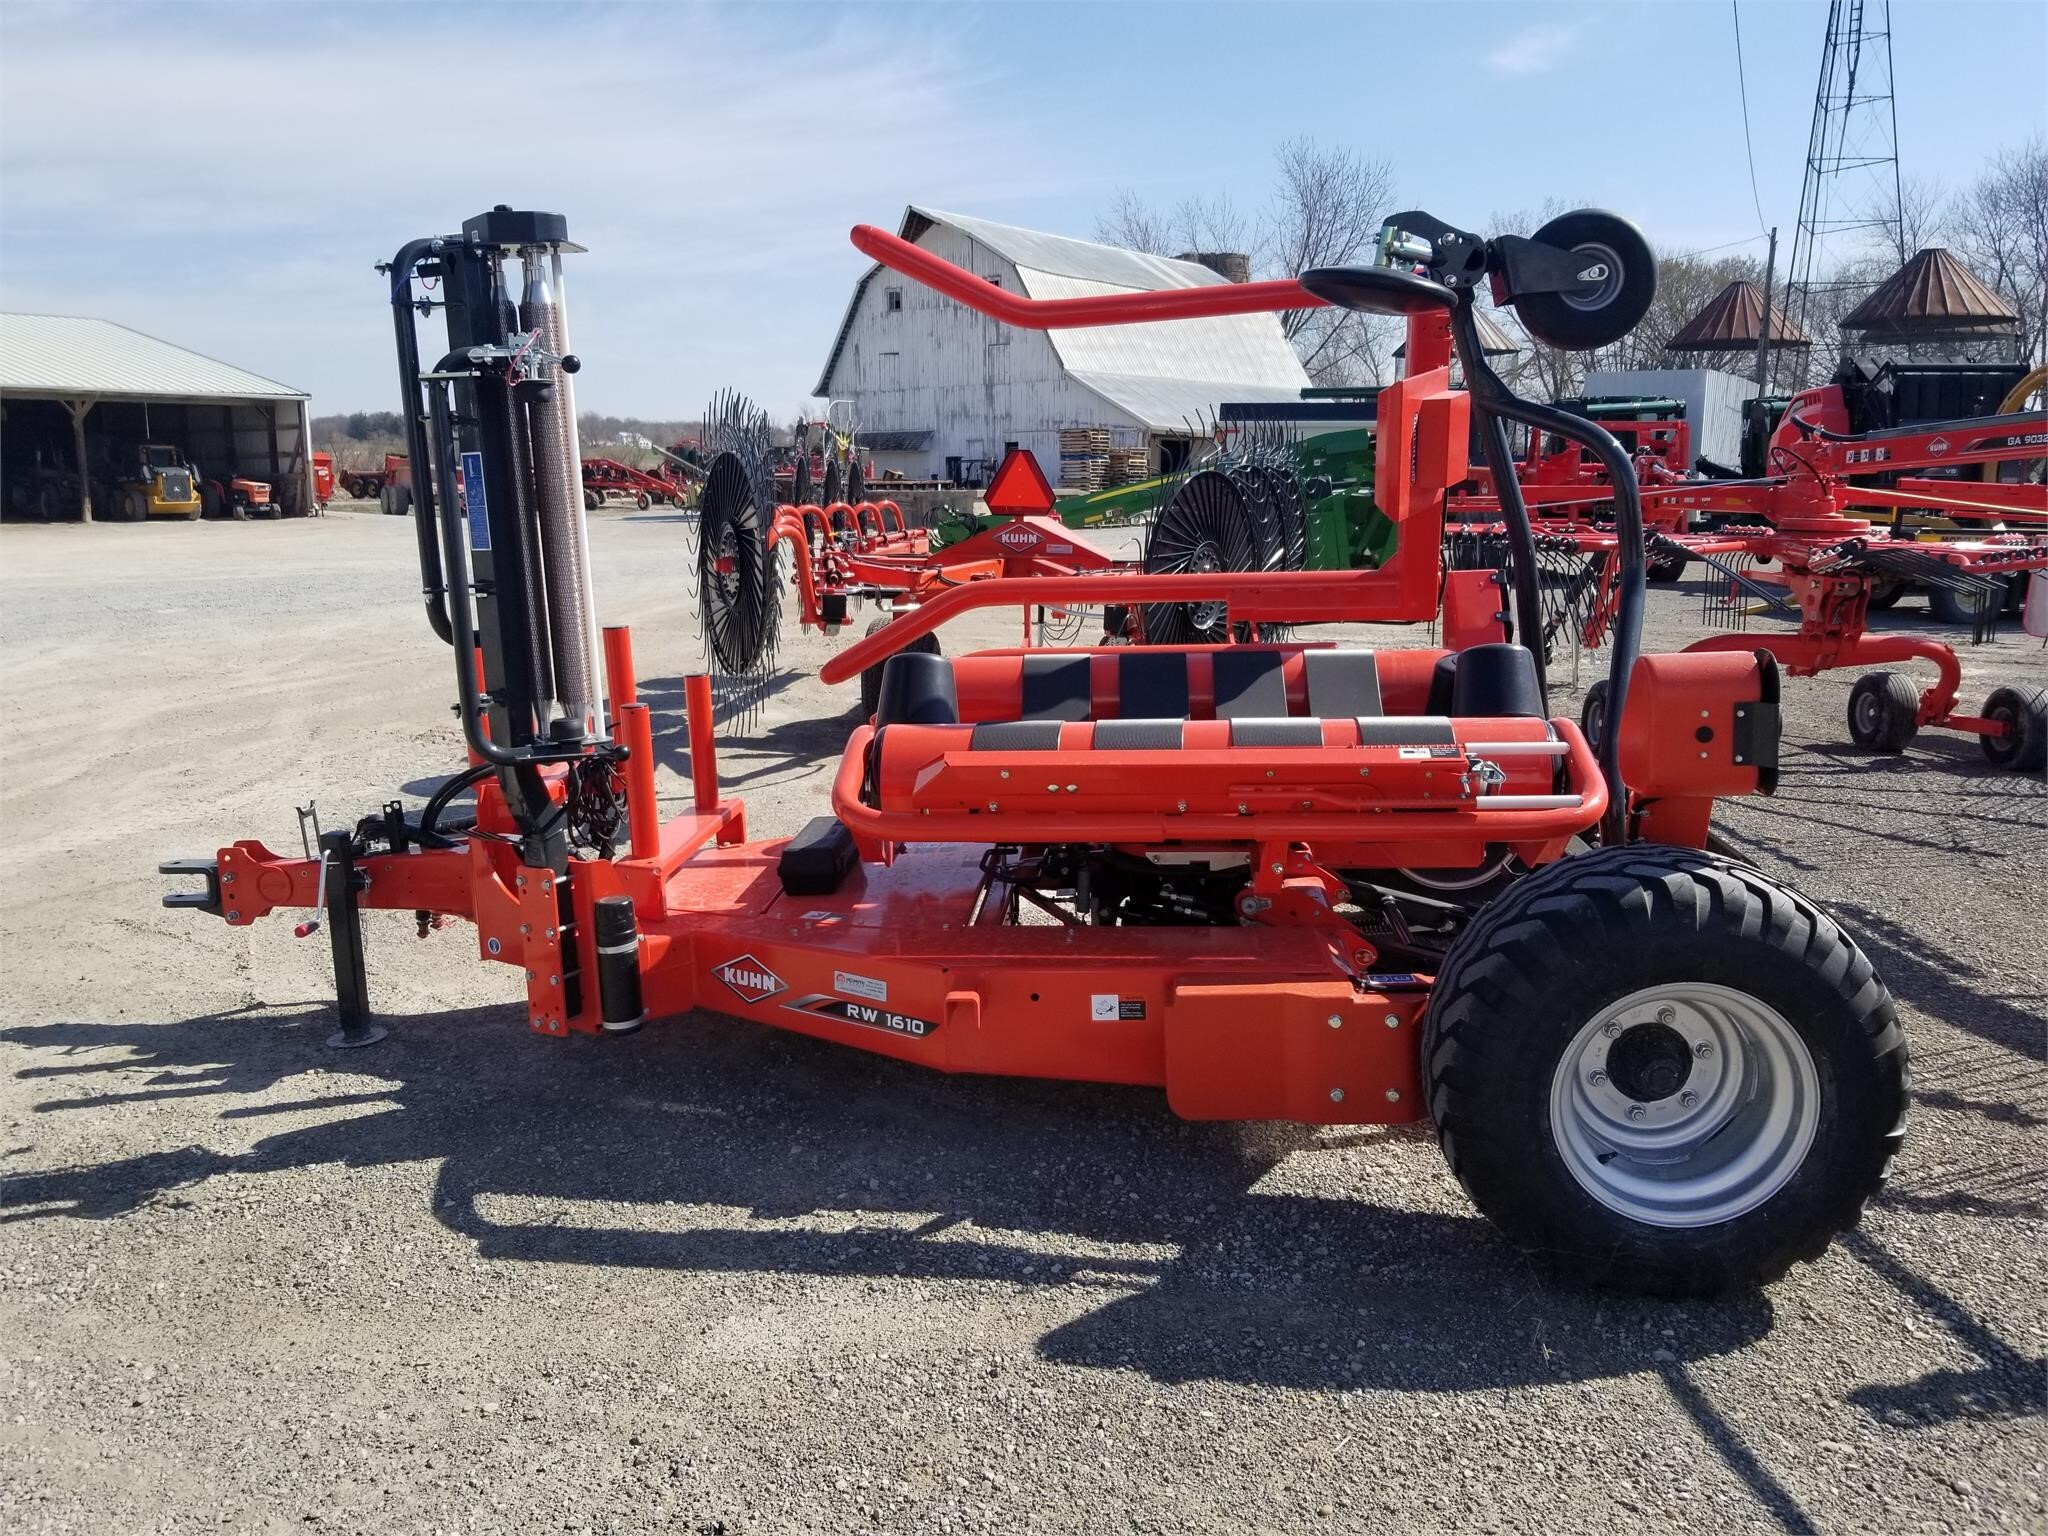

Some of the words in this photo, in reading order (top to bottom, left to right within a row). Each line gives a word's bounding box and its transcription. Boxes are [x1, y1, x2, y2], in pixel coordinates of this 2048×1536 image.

[2007, 436, 2021, 446] GA
[2024, 434, 2048, 444] 9032
[1929, 443, 1948, 452] KUHN
[1001, 533, 1037, 543] KUHN
[724, 967, 776, 992] KUHN
[847, 1003, 878, 1023] RW
[885, 1013, 924, 1034] 1610
